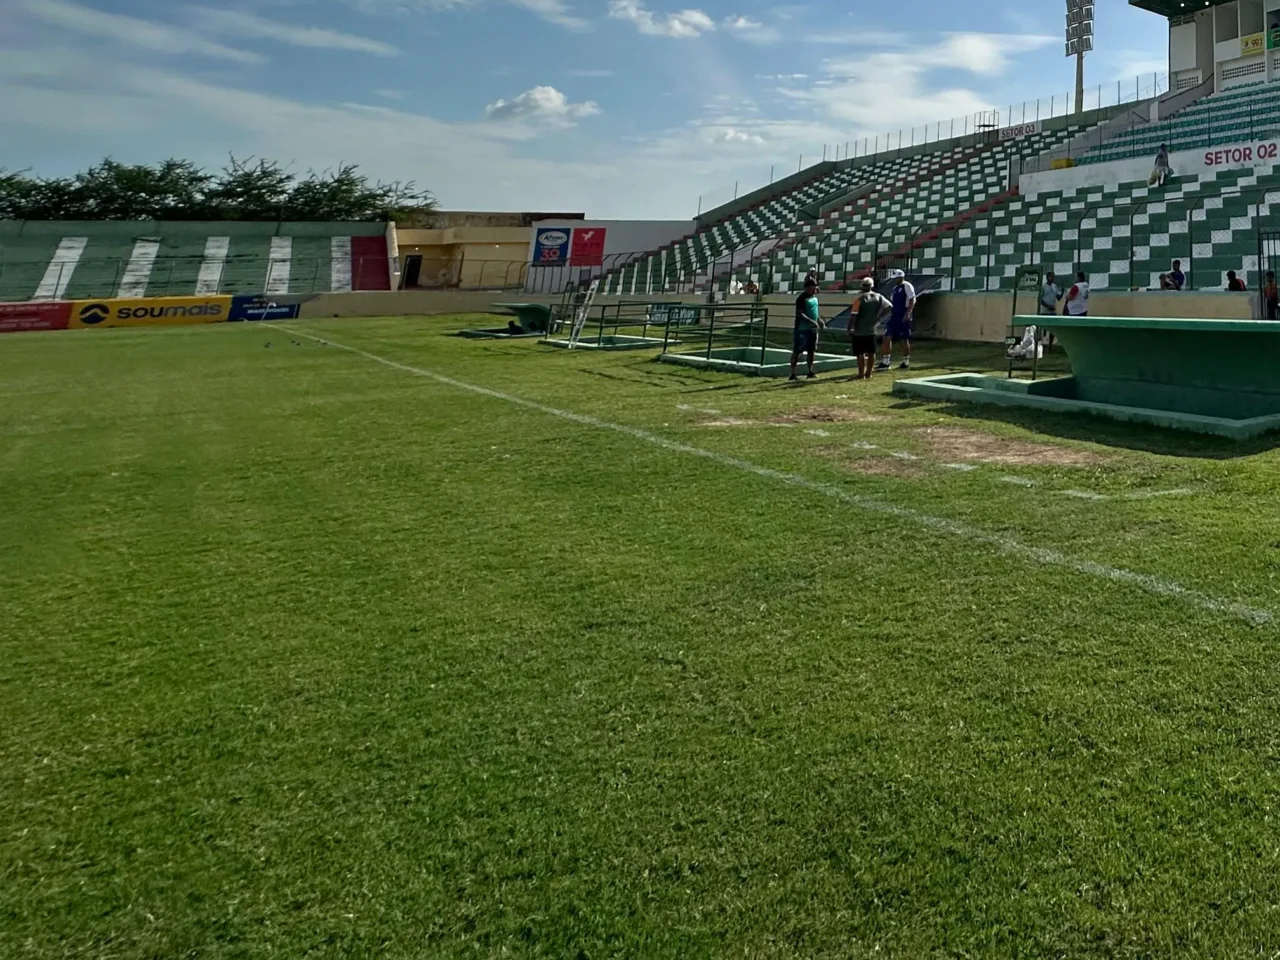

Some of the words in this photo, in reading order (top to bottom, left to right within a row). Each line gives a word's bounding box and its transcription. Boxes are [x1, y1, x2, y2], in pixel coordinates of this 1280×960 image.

[1001, 126, 1024, 138] SETOR
[1025, 123, 1035, 134] 03
[1204, 147, 1252, 166] SETOR
[1257, 143, 1277, 159] 02
[117, 302, 223, 319] soumais
